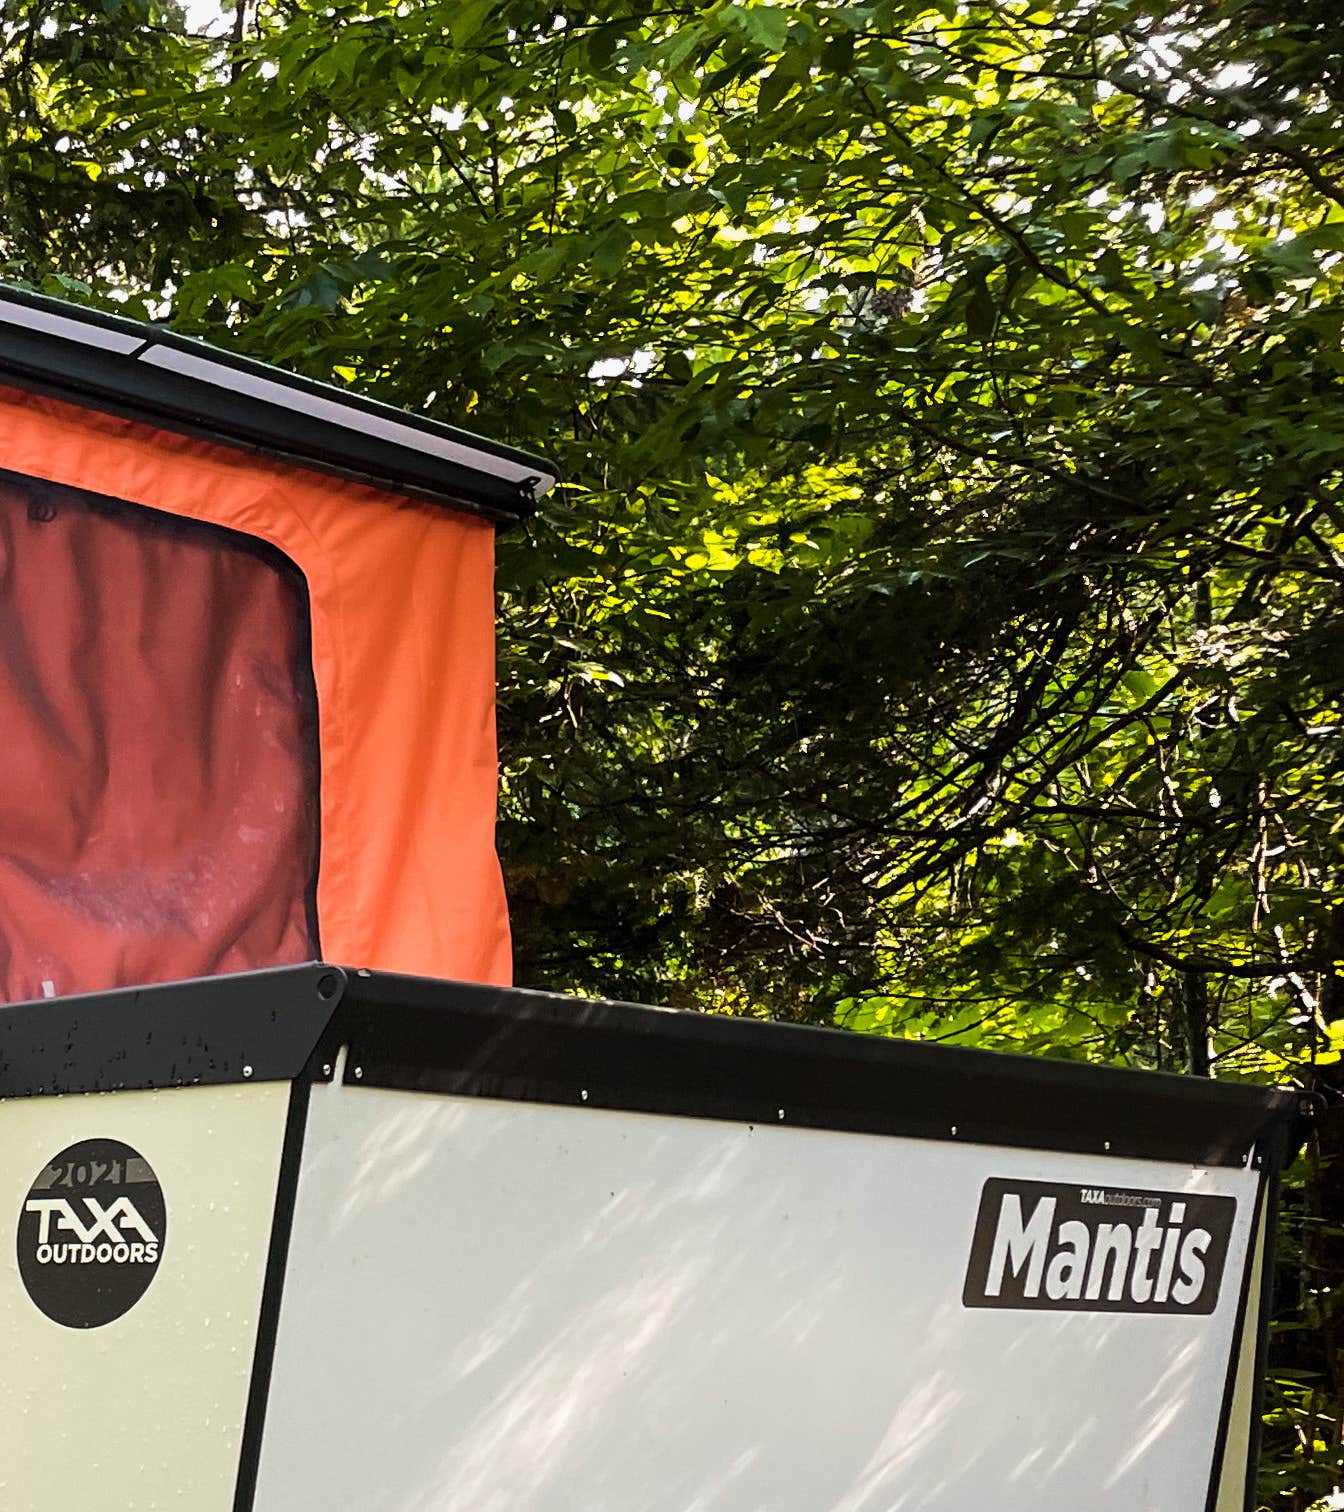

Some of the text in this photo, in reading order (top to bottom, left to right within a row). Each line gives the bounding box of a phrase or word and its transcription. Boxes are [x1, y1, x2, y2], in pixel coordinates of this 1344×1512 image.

[50, 1158, 127, 1190] 2021
[25, 1196, 160, 1244] TAXA
[35, 1242, 159, 1264] OUTDOORS
[984, 1193, 1212, 1305] Mantis
